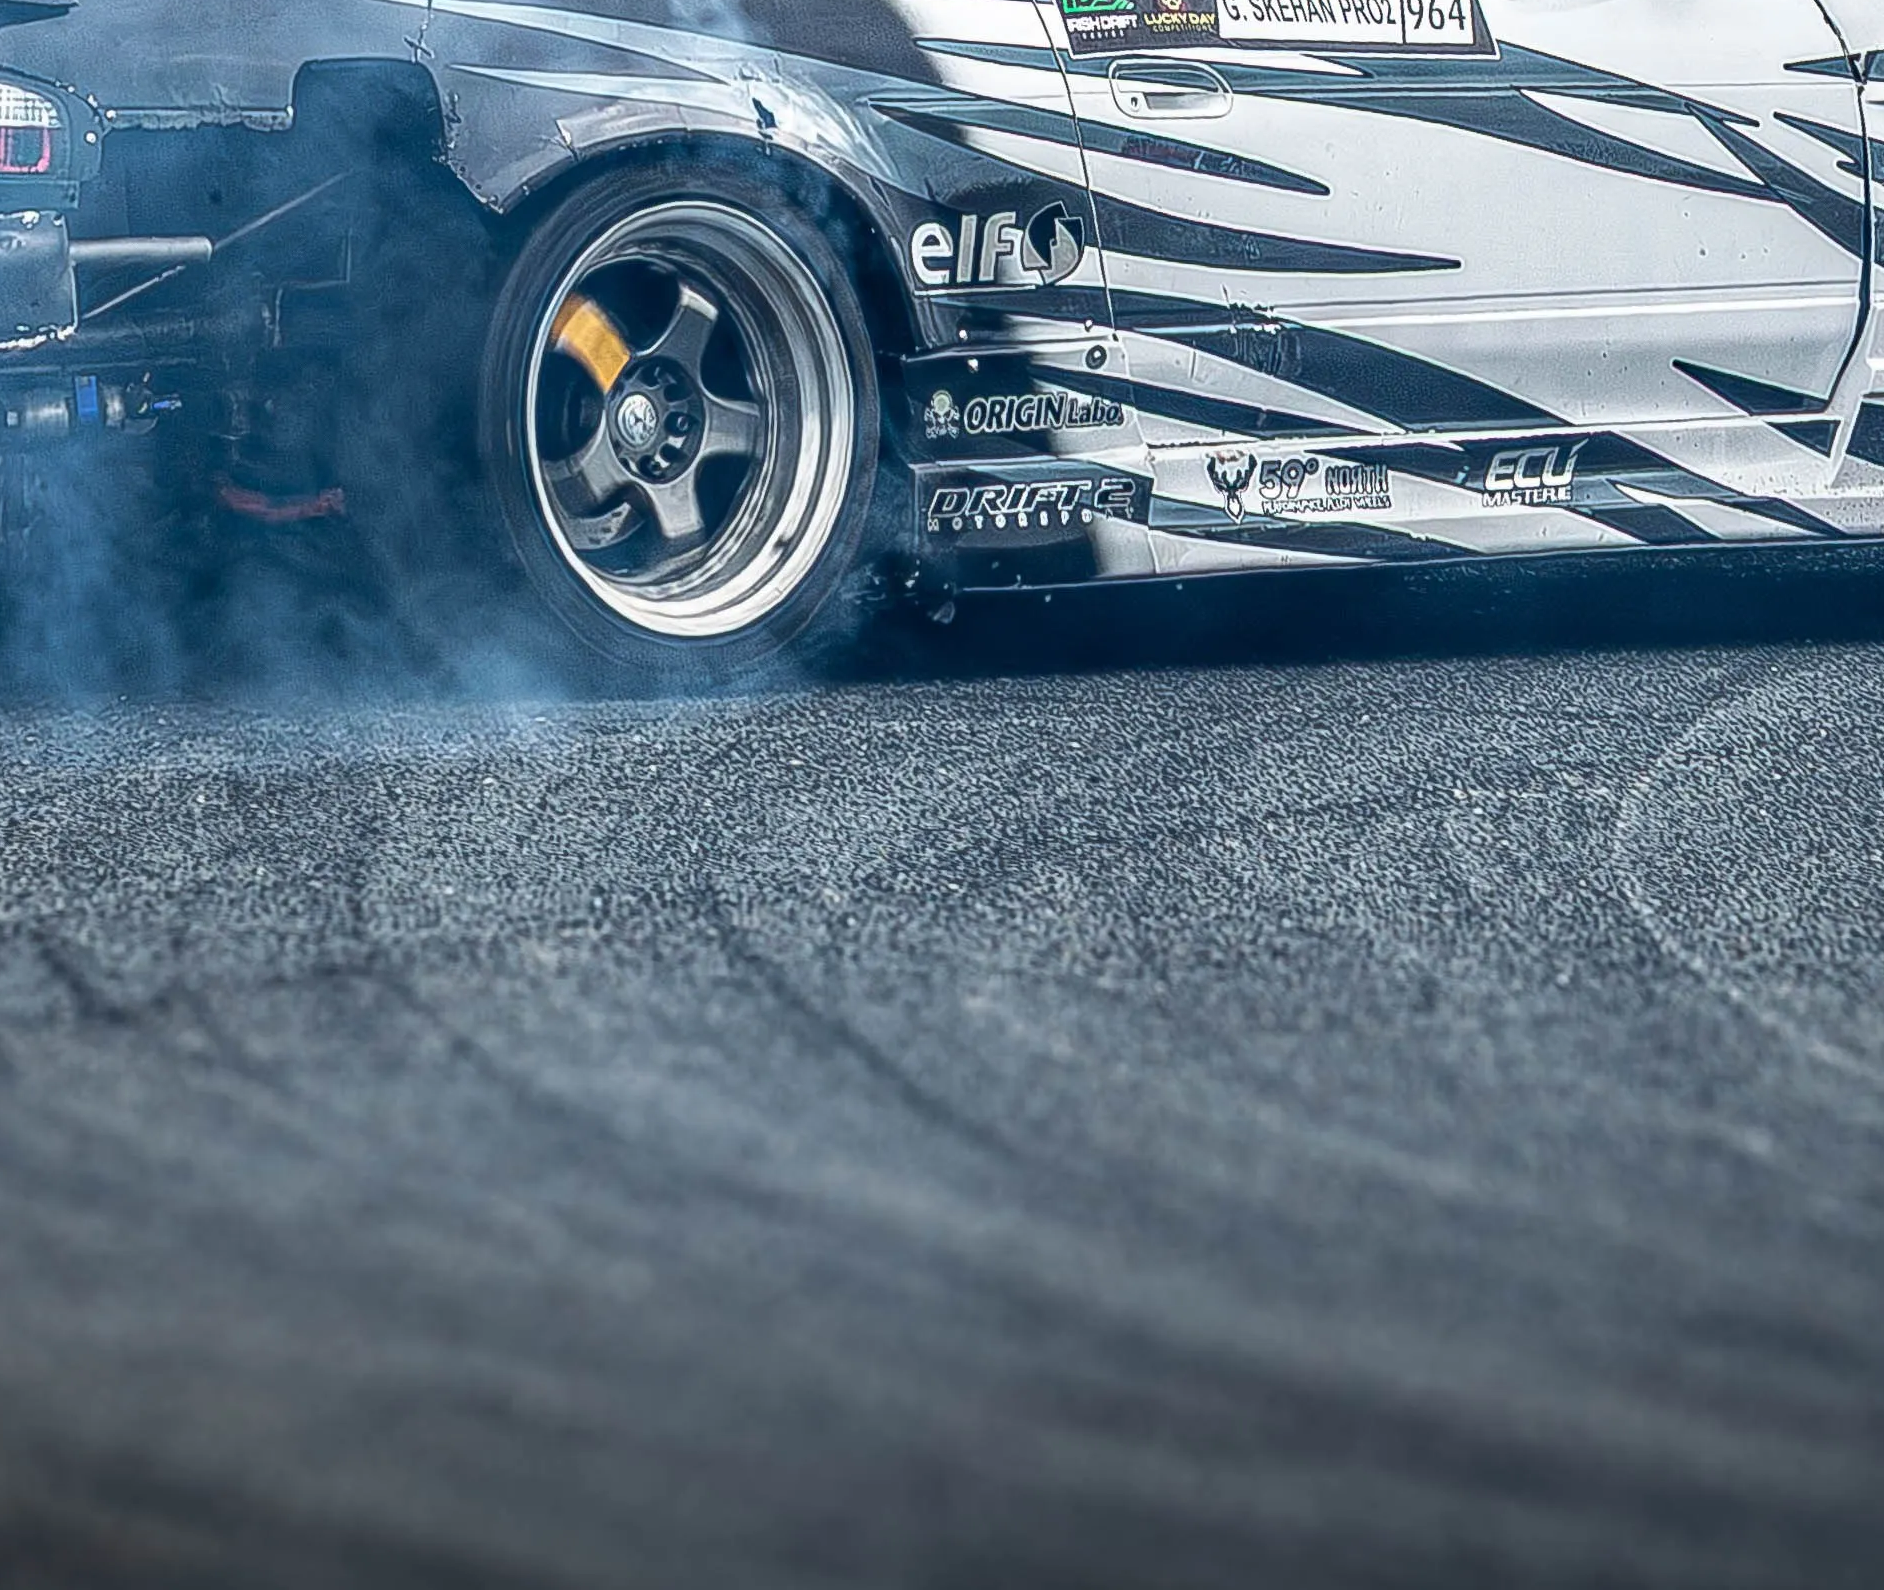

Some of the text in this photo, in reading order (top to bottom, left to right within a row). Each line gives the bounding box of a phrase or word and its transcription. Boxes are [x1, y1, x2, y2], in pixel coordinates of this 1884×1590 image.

[1143, 12, 1215, 25] LUCKY DAY
[911, 211, 1017, 284] elf
[965, 392, 1067, 434] ORIGIN
[1485, 439, 1589, 490] ECU
[928, 478, 1136, 516] DRIFT 2
